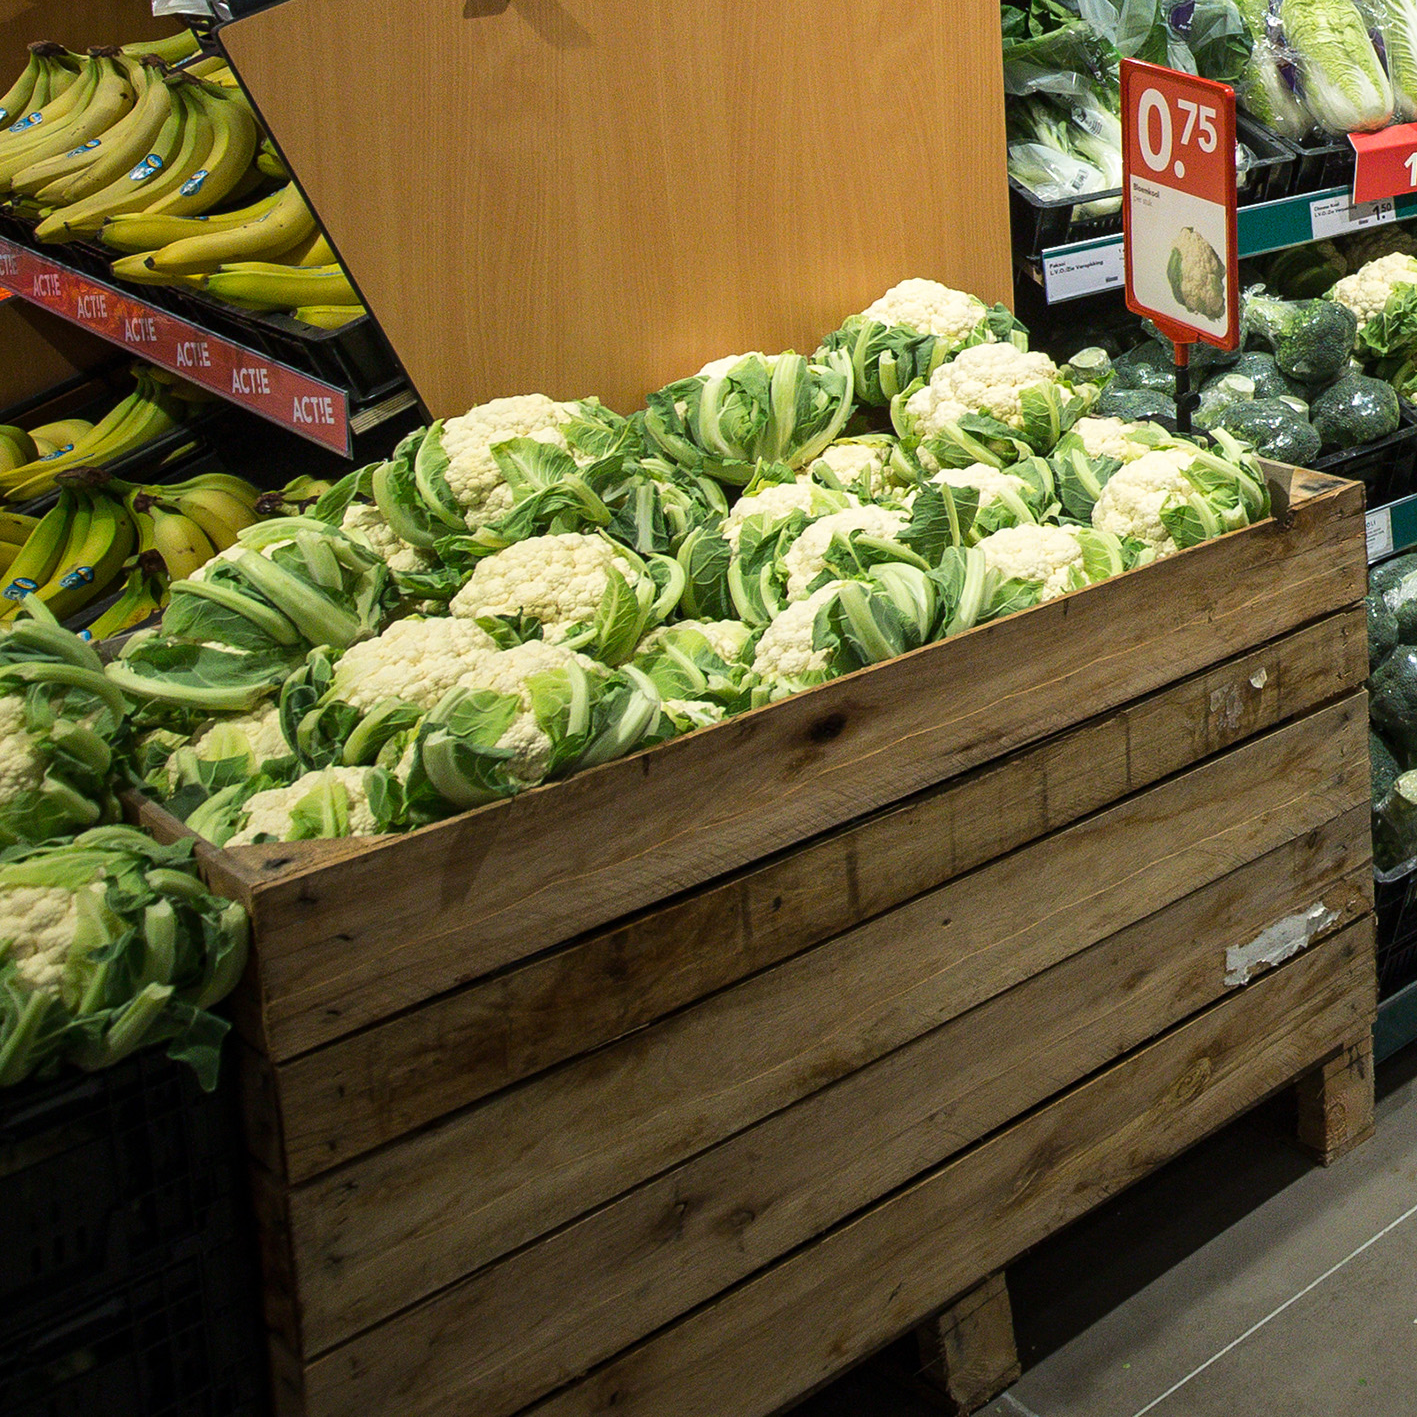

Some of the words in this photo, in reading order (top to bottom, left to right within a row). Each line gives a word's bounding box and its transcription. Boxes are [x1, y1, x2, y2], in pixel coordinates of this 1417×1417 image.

[1137, 87, 1218, 179] 0.75
[1133, 182, 1160, 199] Bloemkool
[1373, 203, 1392, 220] 1.50
